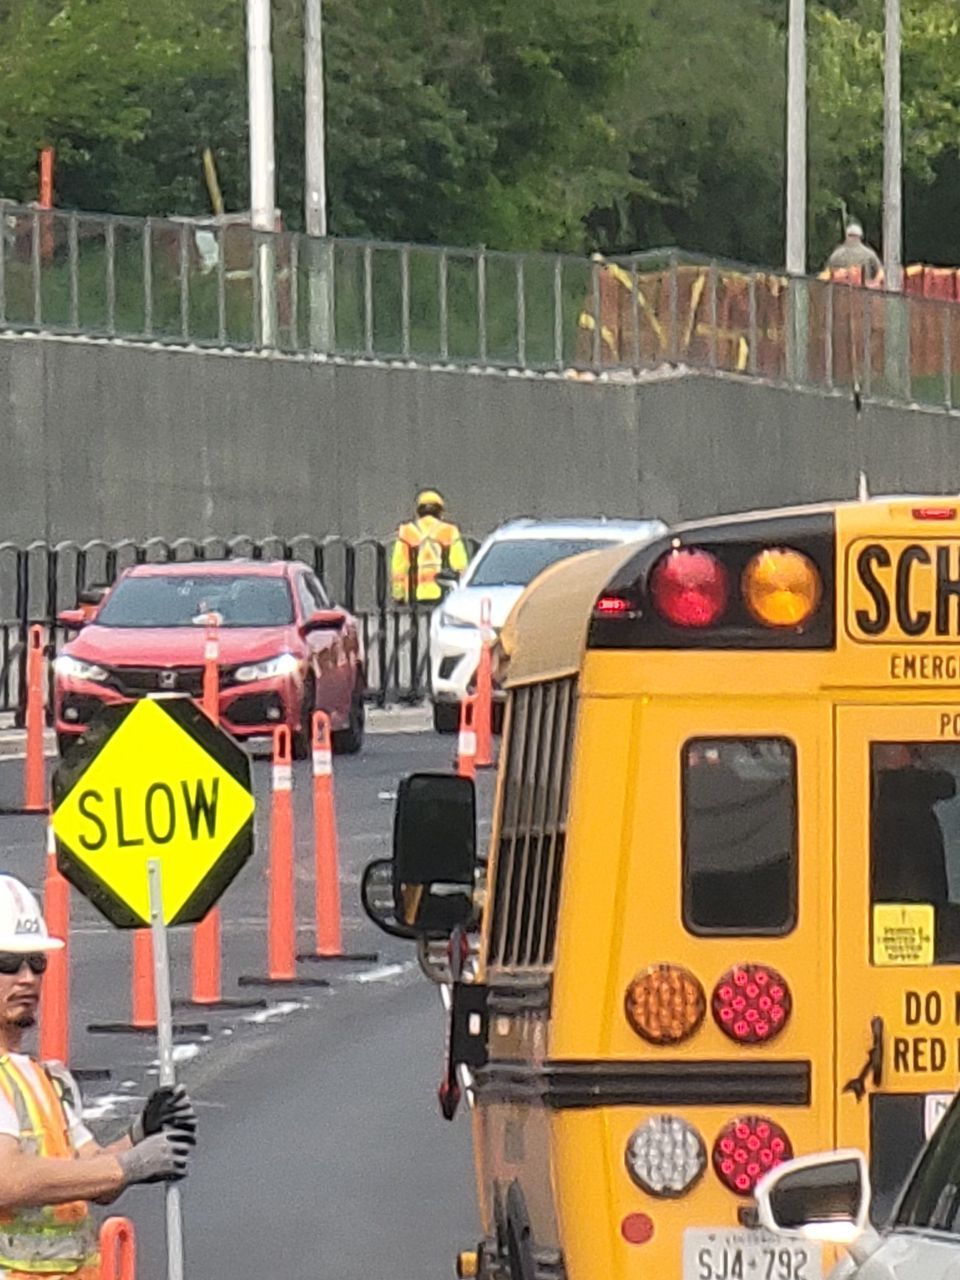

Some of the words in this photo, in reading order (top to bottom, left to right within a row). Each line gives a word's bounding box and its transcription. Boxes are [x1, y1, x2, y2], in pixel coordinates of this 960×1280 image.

[78, 777, 220, 851] SLOW
[905, 991, 942, 1025] DO
[894, 1037, 946, 1072] RED
